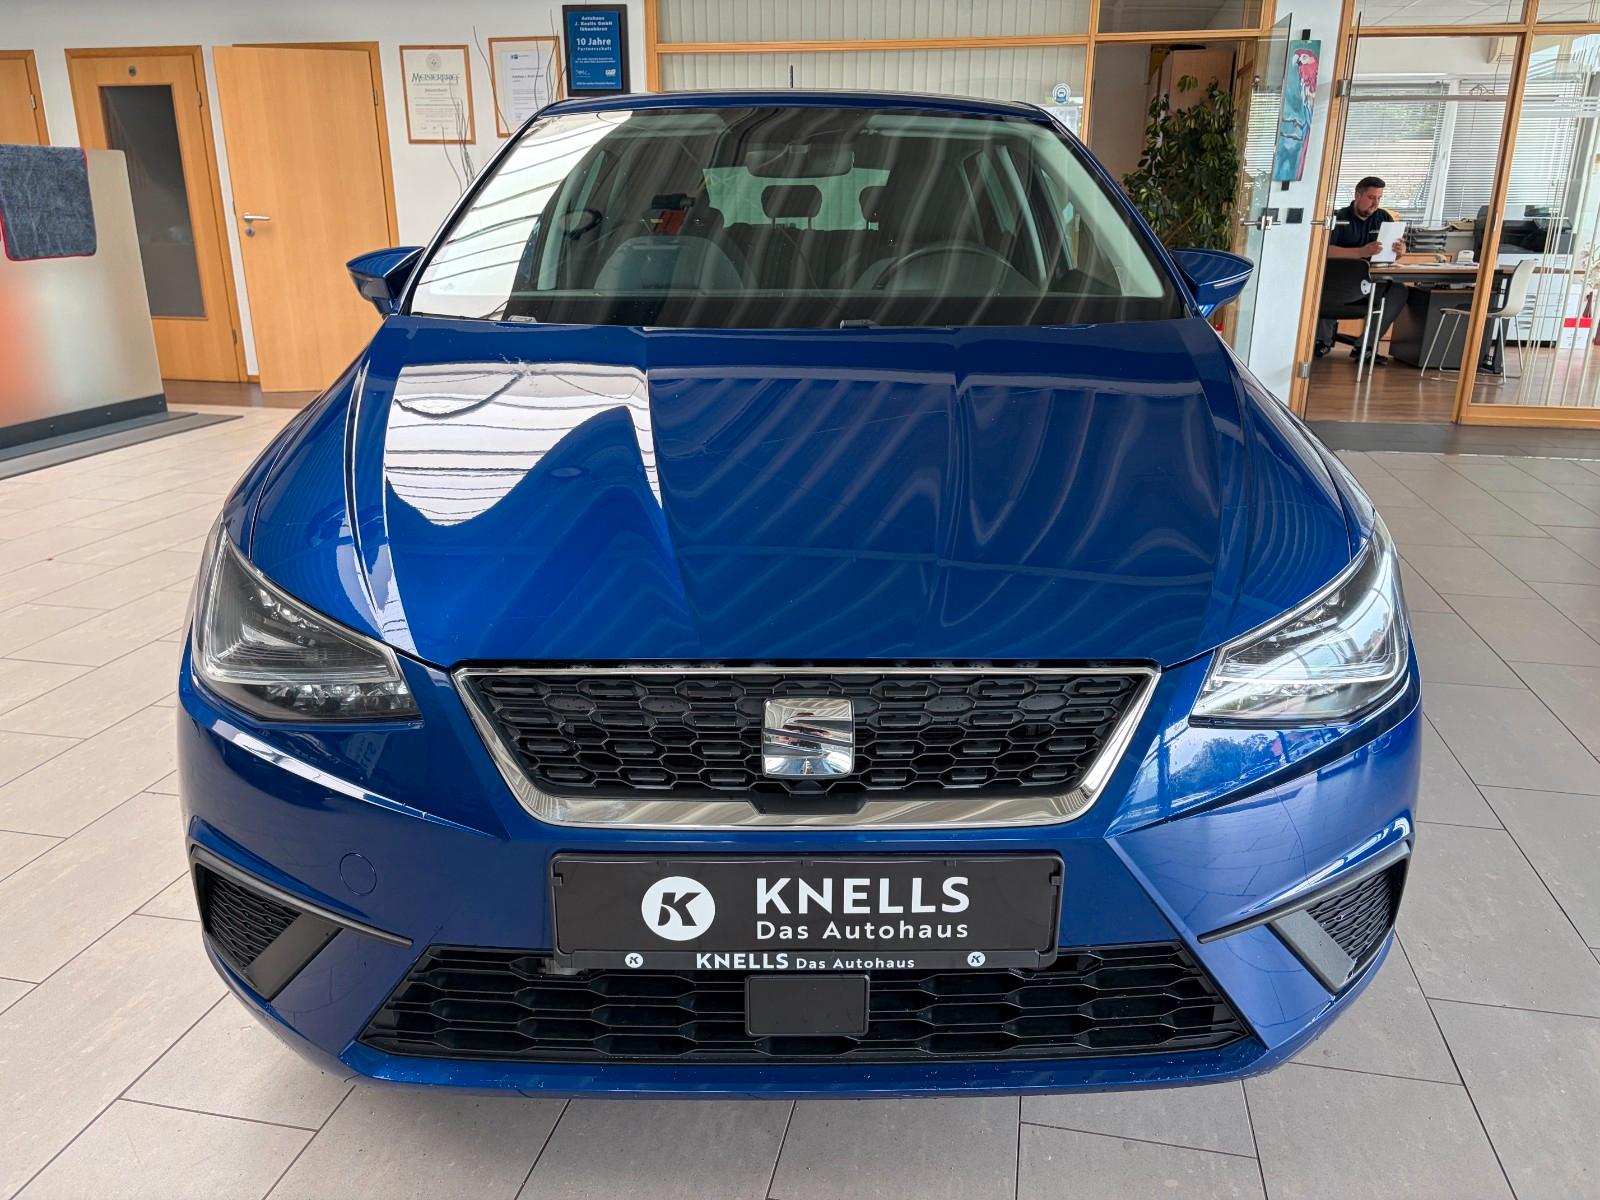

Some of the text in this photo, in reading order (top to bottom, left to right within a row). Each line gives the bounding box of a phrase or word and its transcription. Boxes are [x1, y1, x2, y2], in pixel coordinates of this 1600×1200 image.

[576, 37, 612, 46] 10 Jahre
[756, 877, 970, 915] KNELLS
[756, 920, 969, 940] Das Autohaus
[696, 952, 916, 970] KNELLS Das Autohaus
